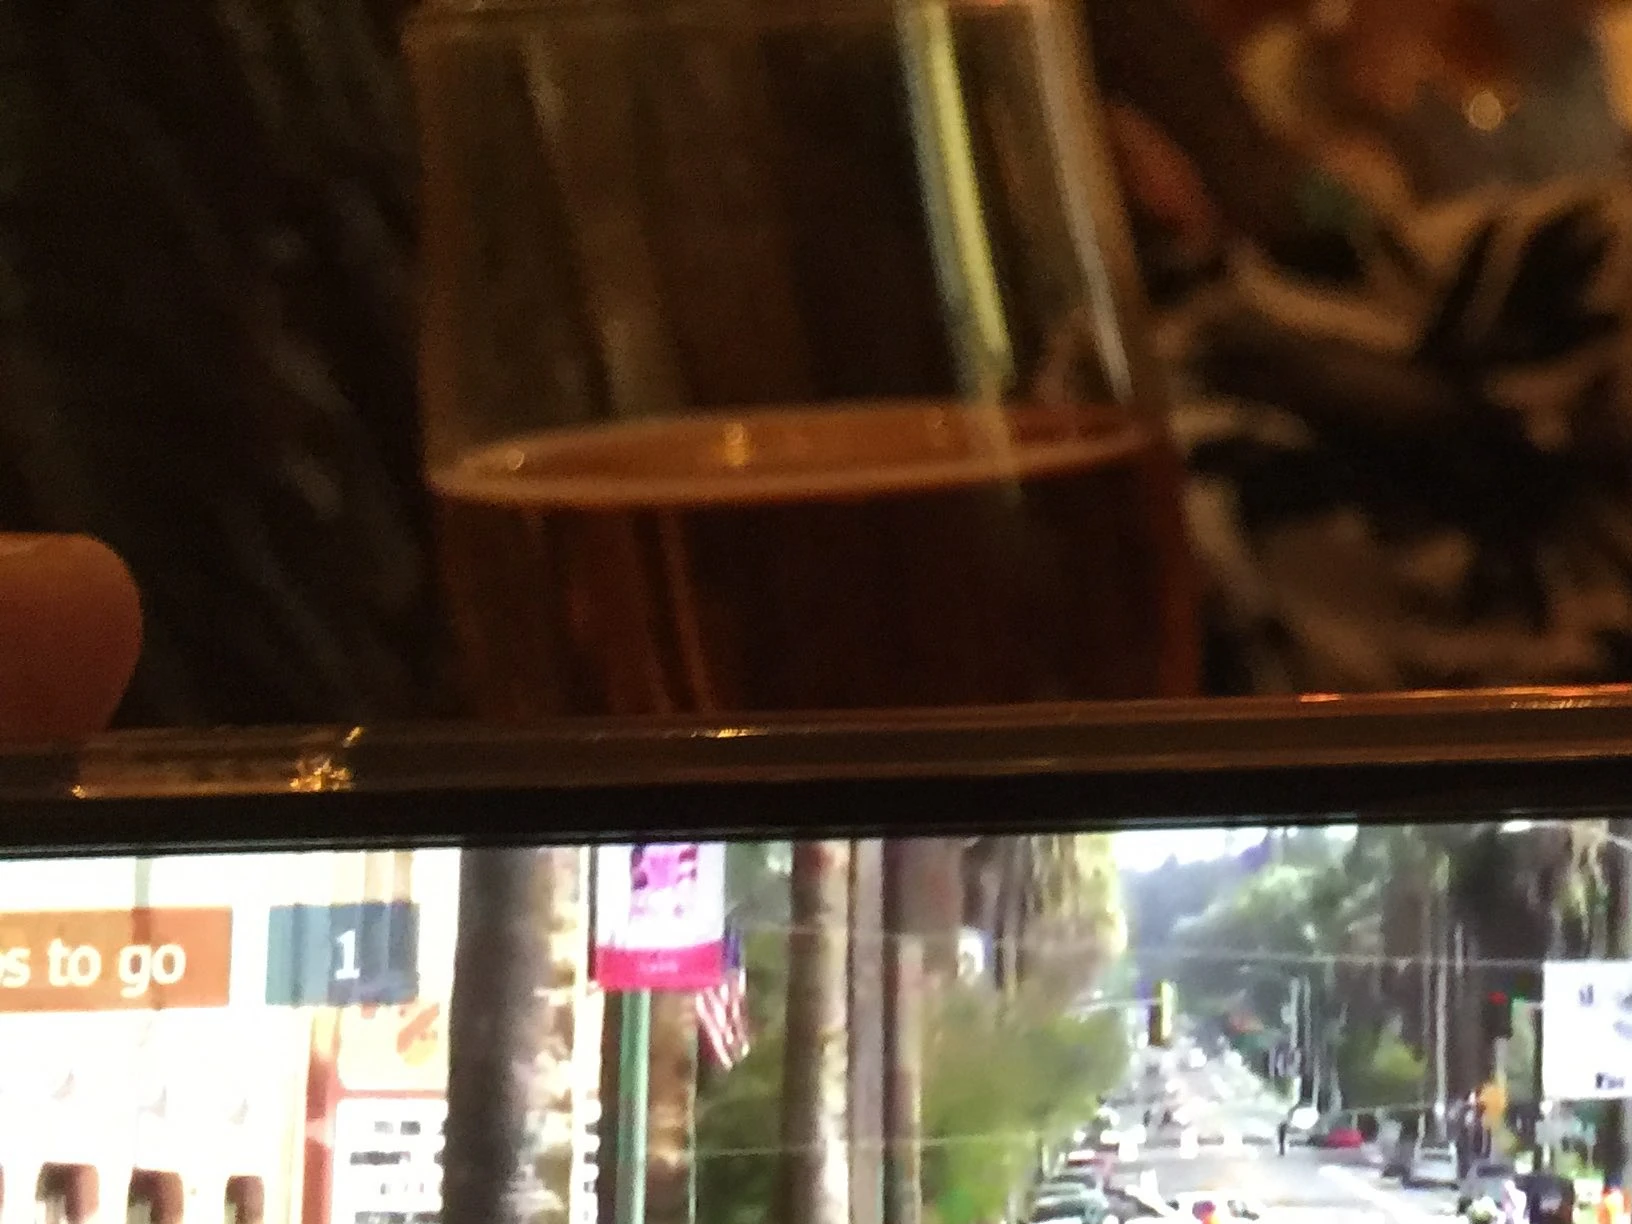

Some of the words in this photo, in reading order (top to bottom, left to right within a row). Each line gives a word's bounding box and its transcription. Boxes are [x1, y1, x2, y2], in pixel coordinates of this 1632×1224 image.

[47, 938, 101, 987] to
[117, 943, 187, 998] go
[334, 928, 361, 980] 1
